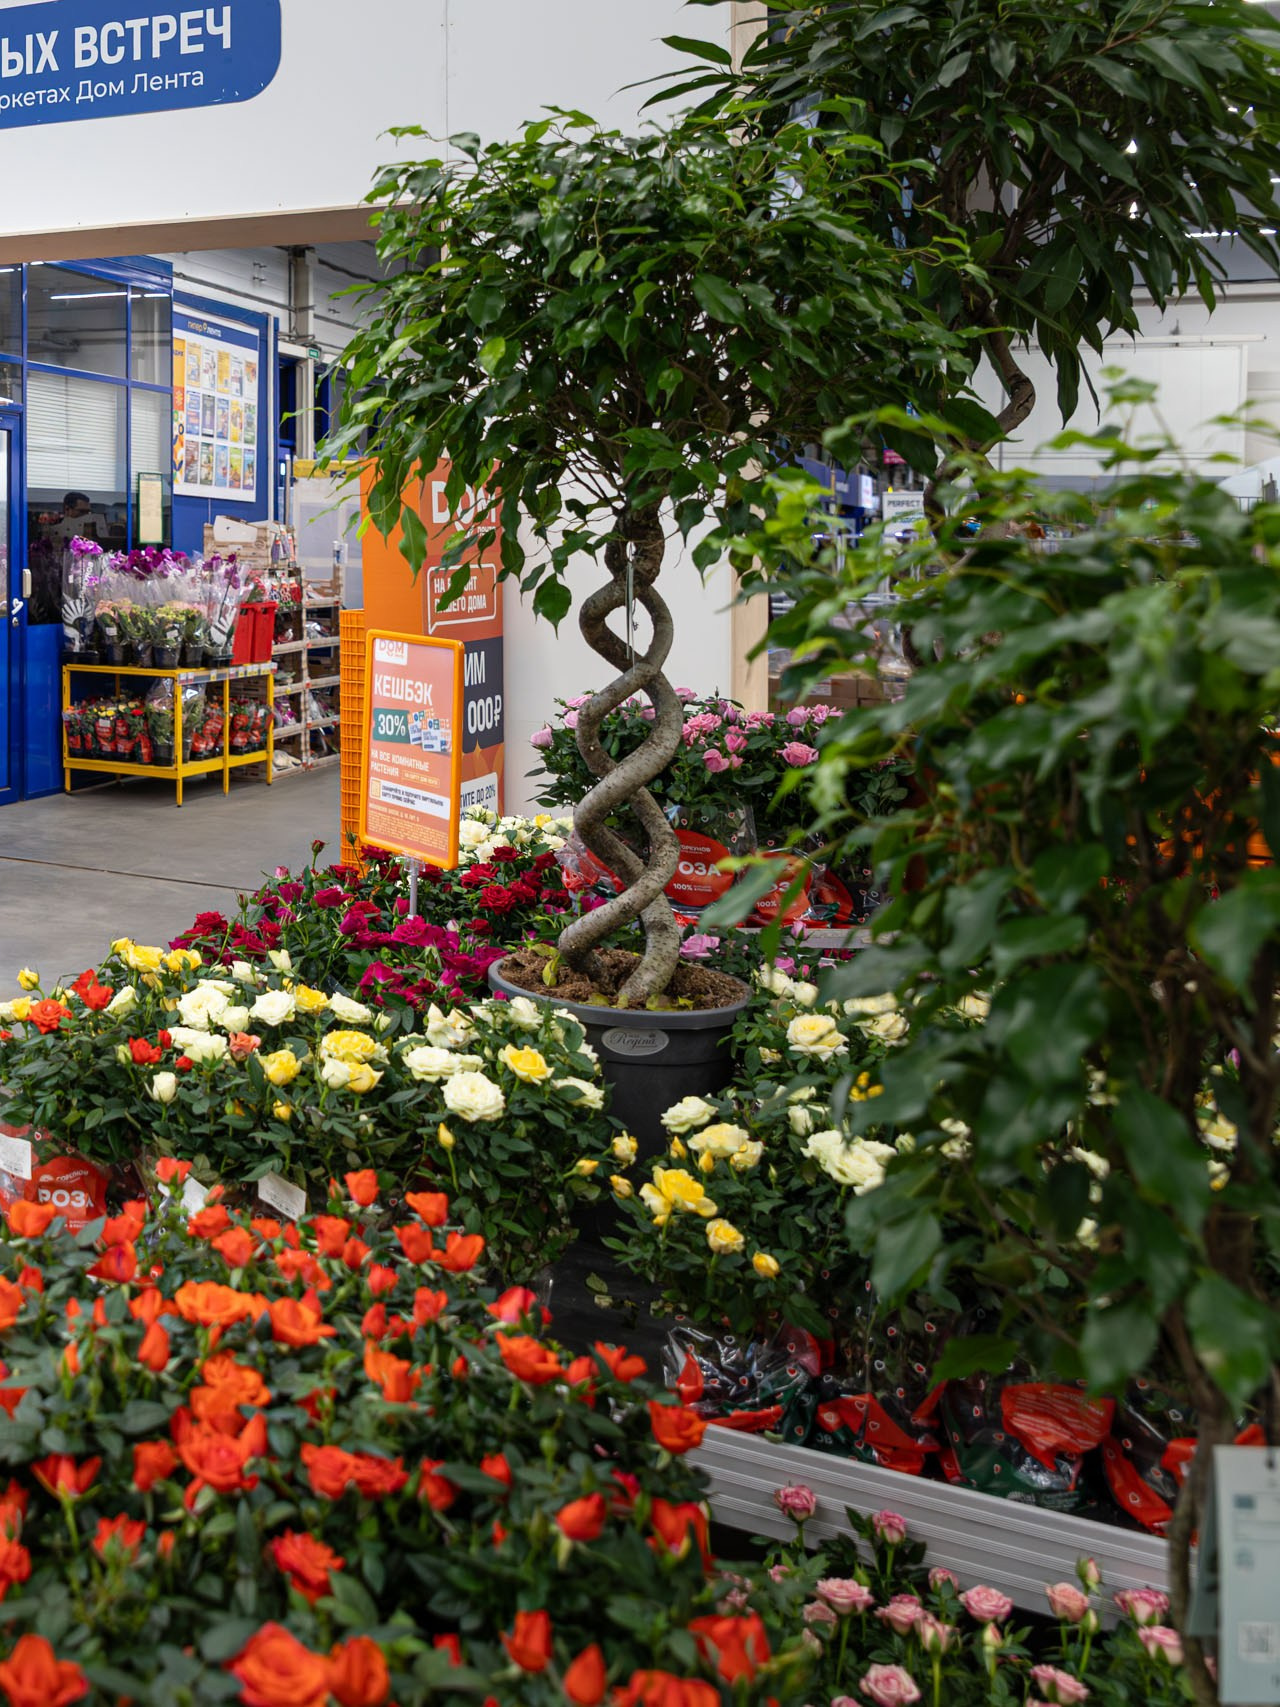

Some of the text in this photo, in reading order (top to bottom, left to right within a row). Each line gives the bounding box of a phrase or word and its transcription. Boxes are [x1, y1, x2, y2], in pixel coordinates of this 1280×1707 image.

[74, 5, 232, 68] ВСТРЕЧ
[76, 81, 125, 105] Дом
[130, 68, 205, 95] Лента
[374, 673, 433, 706] КЕШБЭК
[378, 714, 406, 736] 30%
[678, 861, 721, 877] ОЗА
